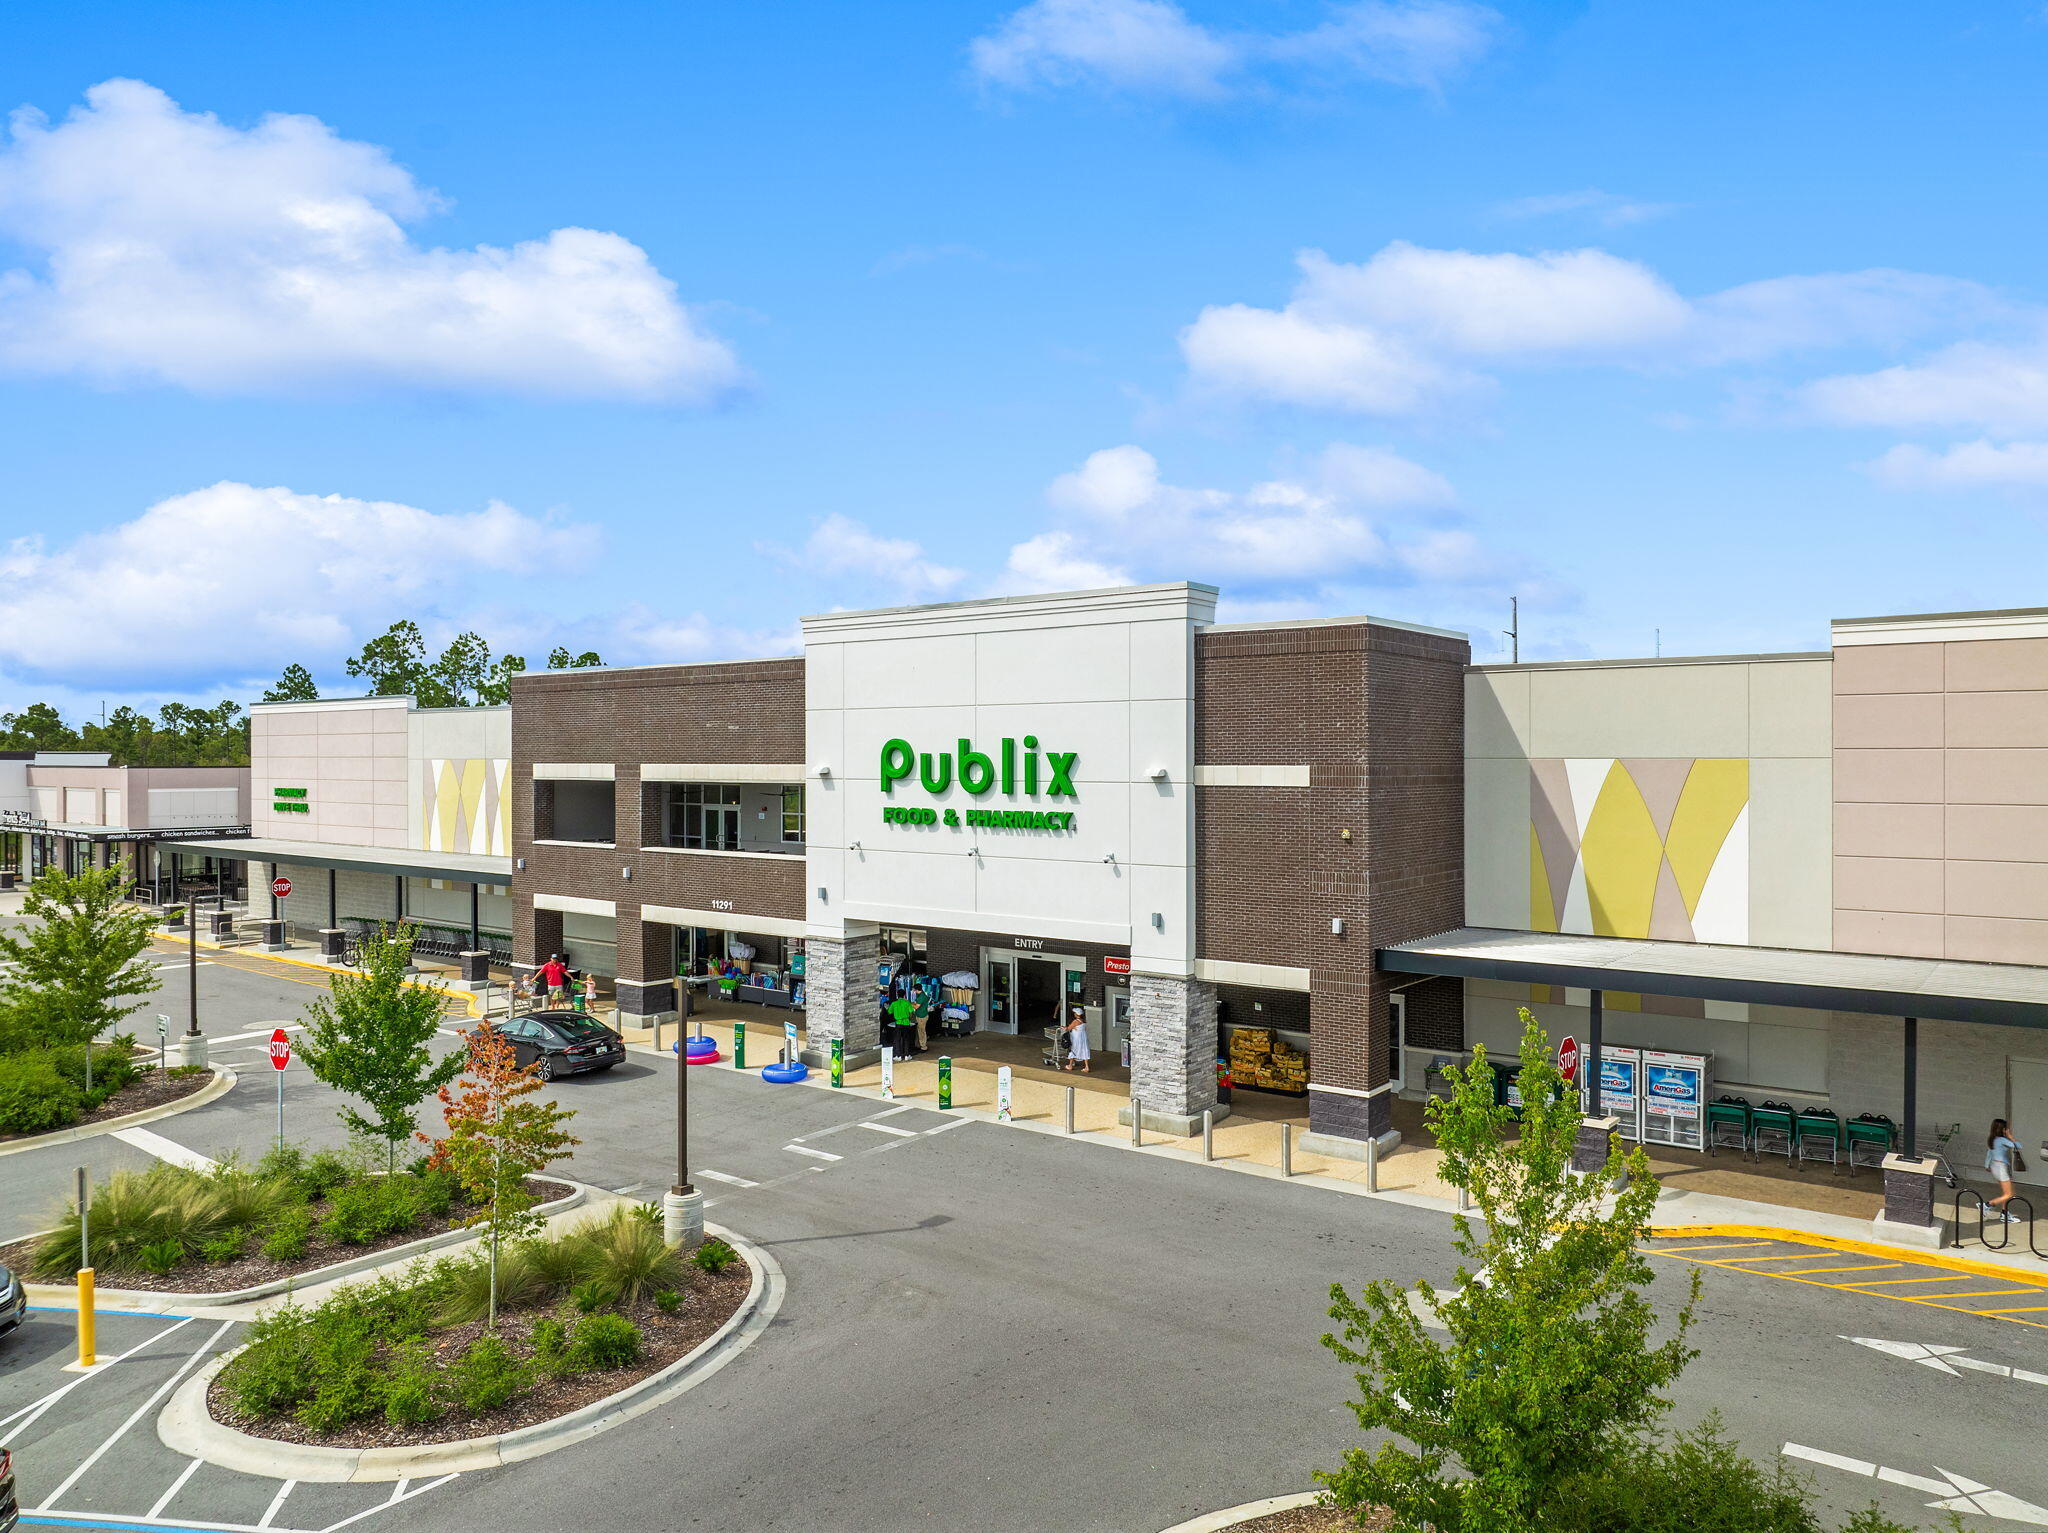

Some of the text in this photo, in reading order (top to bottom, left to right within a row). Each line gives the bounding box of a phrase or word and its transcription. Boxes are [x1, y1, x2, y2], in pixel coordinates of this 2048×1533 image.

[881, 735, 1077, 796] Publix
[883, 807, 1074, 830] FOOD & PHARMACY
[274, 884, 290, 892] STOP
[712, 900, 733, 910] 11291
[1015, 938, 1044, 949] ENTRY
[1107, 961, 1130, 971] Presto
[271, 1041, 288, 1057] STOP
[1560, 1050, 1576, 1070] STOP
[1653, 1084, 1691, 1095] AmeriGas
